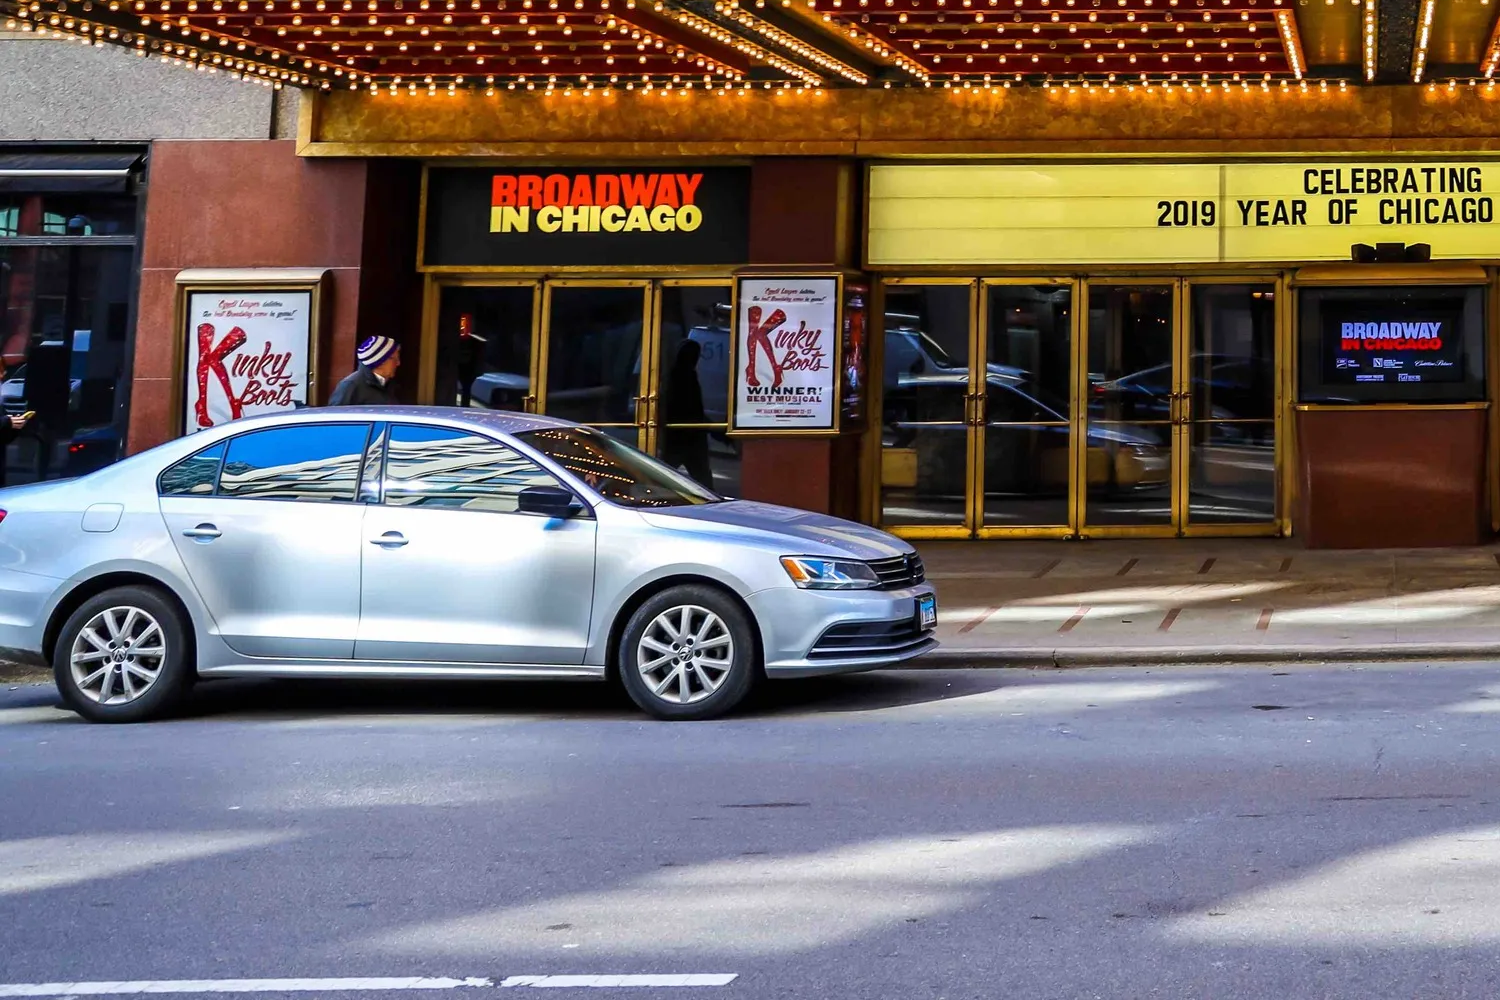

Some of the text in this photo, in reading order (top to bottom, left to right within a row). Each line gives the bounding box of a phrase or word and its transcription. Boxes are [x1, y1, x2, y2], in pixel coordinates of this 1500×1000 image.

[491, 174, 704, 209] BROADWAY
[1303, 167, 1482, 195] CELEBRATING
[489, 205, 703, 233] IN CHICAGO
[1157, 200, 1217, 227] 2019
[1236, 199, 1307, 226] YEAR
[1328, 198, 1358, 225] OF
[1378, 197, 1494, 225] CHICAGO
[1341, 322, 1442, 340] BROADWAY
[1341, 338, 1443, 351] IN CHICAGO
[782, 350, 830, 372] Boots
[240, 380, 299, 407] Boots
[747, 386, 823, 396] WINNER!
[747, 395, 822, 403] BEST MUSICAL
